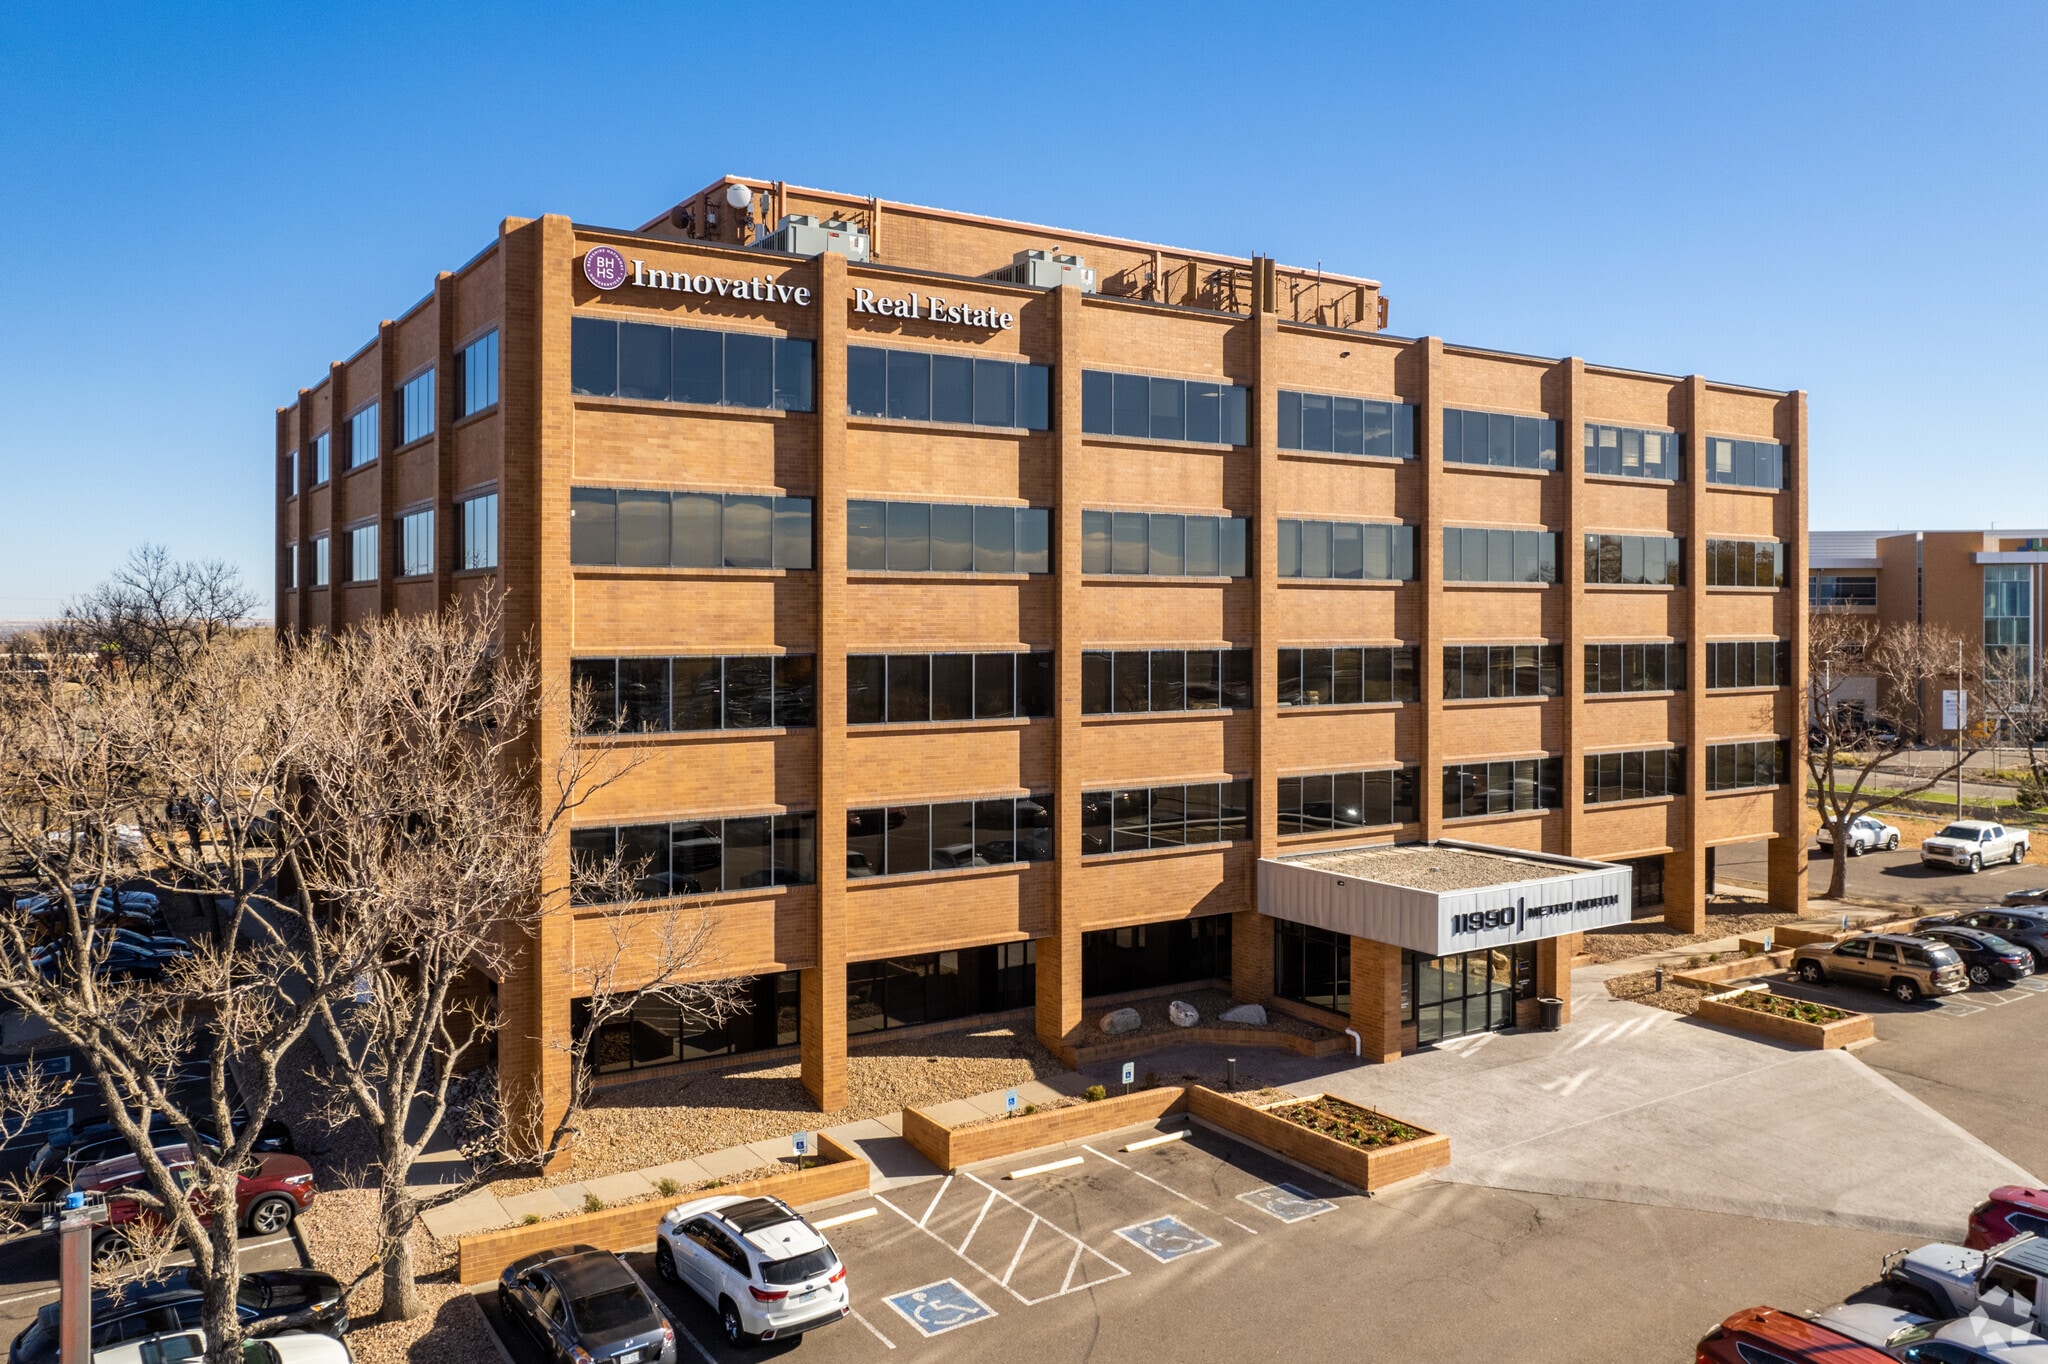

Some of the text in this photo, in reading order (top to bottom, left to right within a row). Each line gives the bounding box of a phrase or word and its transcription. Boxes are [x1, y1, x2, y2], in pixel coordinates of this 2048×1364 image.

[596, 256, 615, 269] BH
[596, 267, 614, 280] HS
[631, 258, 811, 306] Innovative
[853, 286, 1014, 330] Real Estate
[1453, 894, 1619, 934] 11990 METRO NORTH
